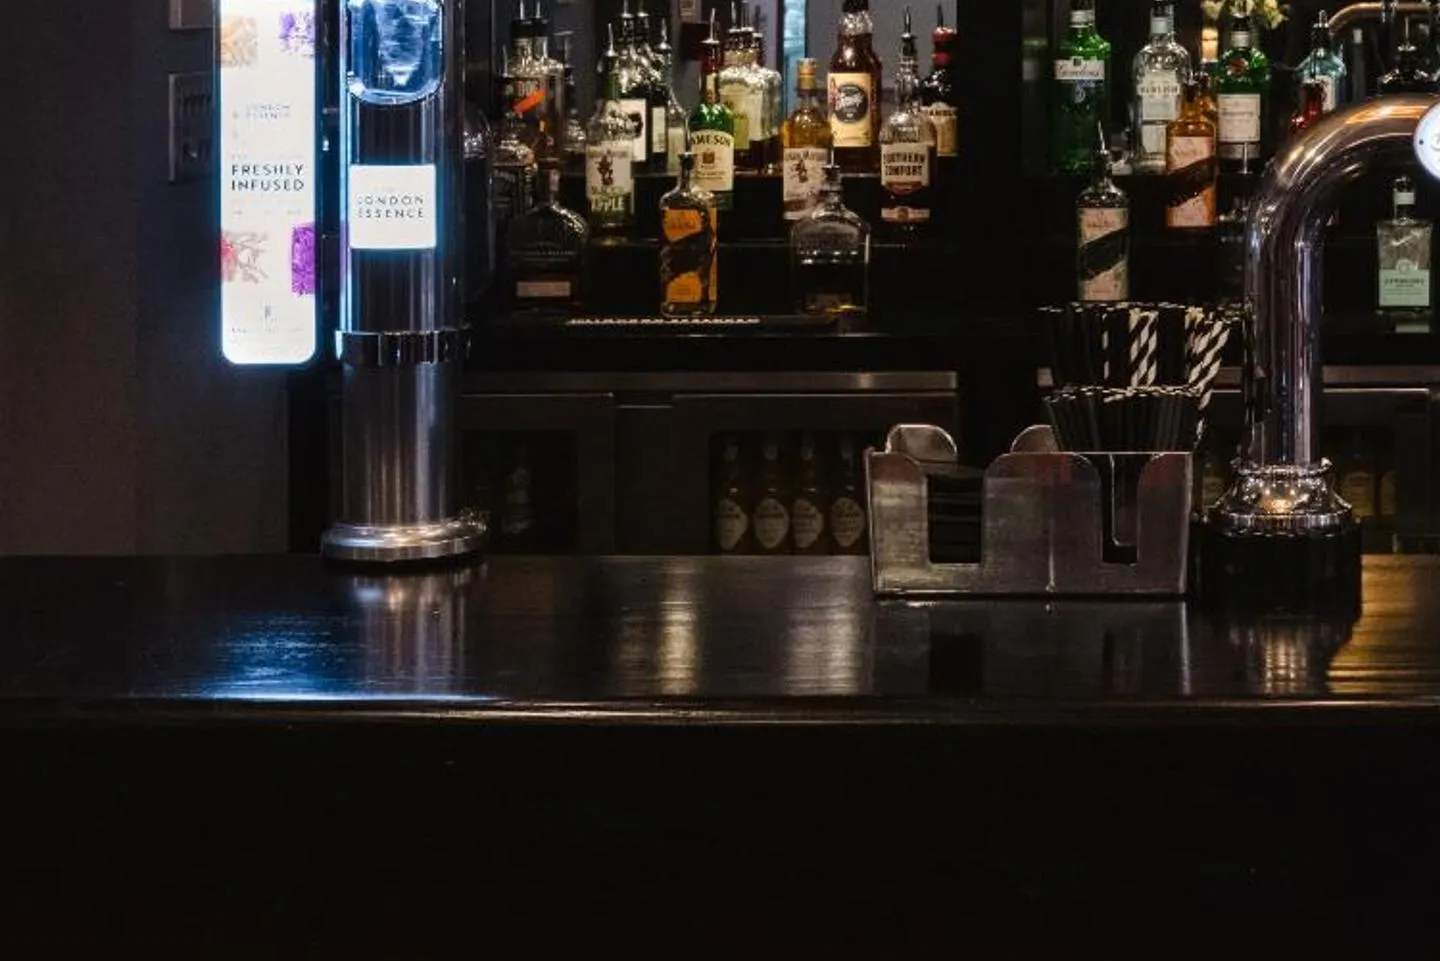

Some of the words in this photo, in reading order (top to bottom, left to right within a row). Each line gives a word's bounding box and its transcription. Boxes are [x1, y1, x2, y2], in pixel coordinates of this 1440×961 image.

[688, 133, 732, 147] AMESON
[232, 163, 304, 176] FRESHLY
[232, 178, 305, 191] INFUSED
[357, 208, 424, 219] ESSENCE
